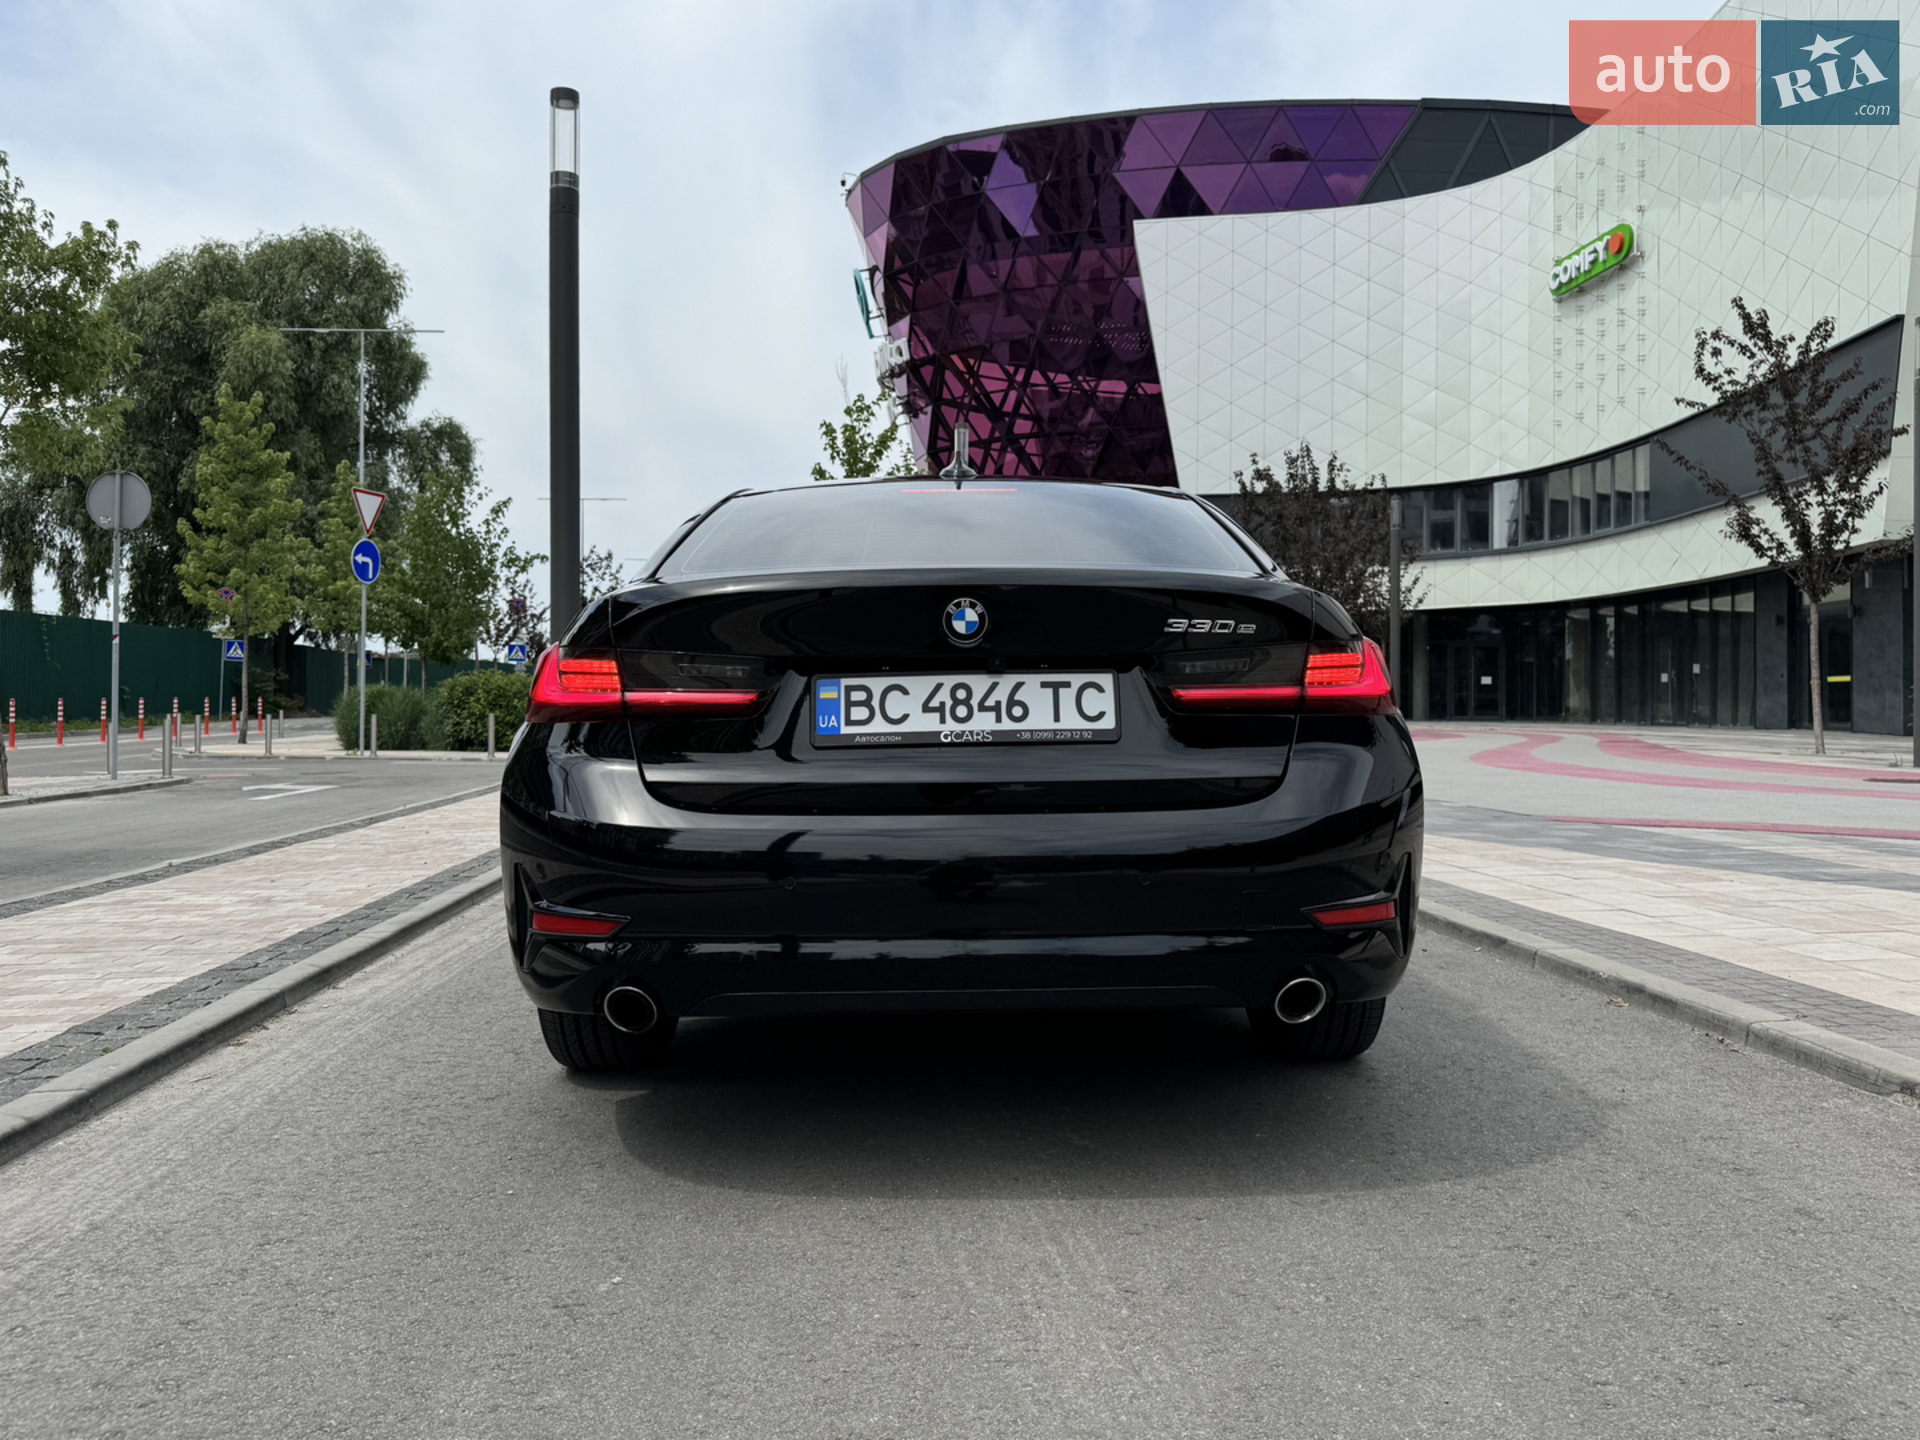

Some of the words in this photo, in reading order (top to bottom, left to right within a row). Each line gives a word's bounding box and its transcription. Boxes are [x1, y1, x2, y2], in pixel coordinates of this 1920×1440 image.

[1549, 235, 1612, 290] COMFY
[947, 599, 984, 614] BMW
[844, 683, 910, 727] BC
[921, 681, 1030, 724] 4846
[1040, 681, 1107, 723] TC
[819, 714, 838, 728] UA
[854, 735, 902, 743] Автосалон
[940, 730, 993, 743] GCARS
[1016, 731, 1031, 740] +38
[1033, 731, 1054, 740] (099)
[1055, 731, 1071, 739] 229
[1072, 731, 1080, 739] 12
[1082, 731, 1093, 739] 92
